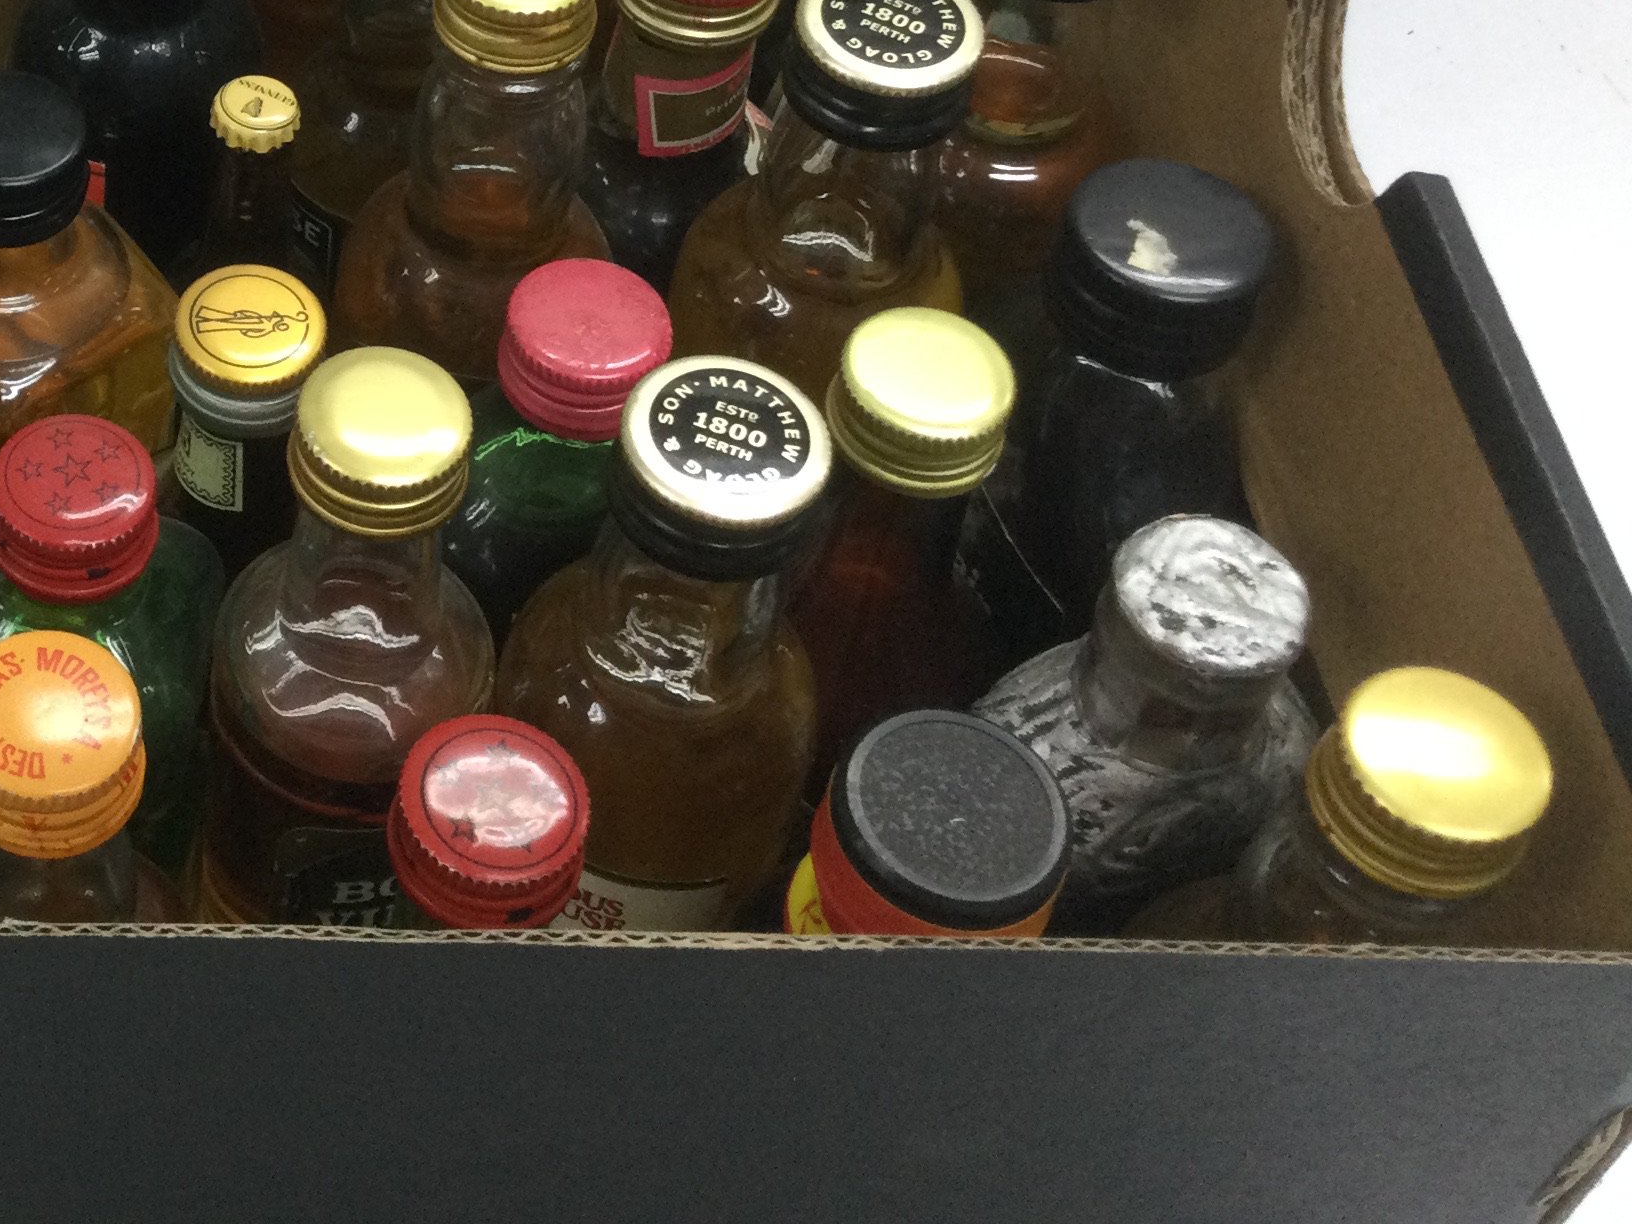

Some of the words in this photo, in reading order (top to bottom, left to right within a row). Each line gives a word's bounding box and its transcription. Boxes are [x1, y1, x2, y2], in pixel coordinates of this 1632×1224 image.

[858, 18, 912, 45] PERTH
[860, 2, 927, 35] 1800
[845, 36, 934, 65] GLOAG
[692, 411, 768, 449] 1800
[708, 374, 802, 463] MATTHEW
[694, 432, 754, 463] PERTH
